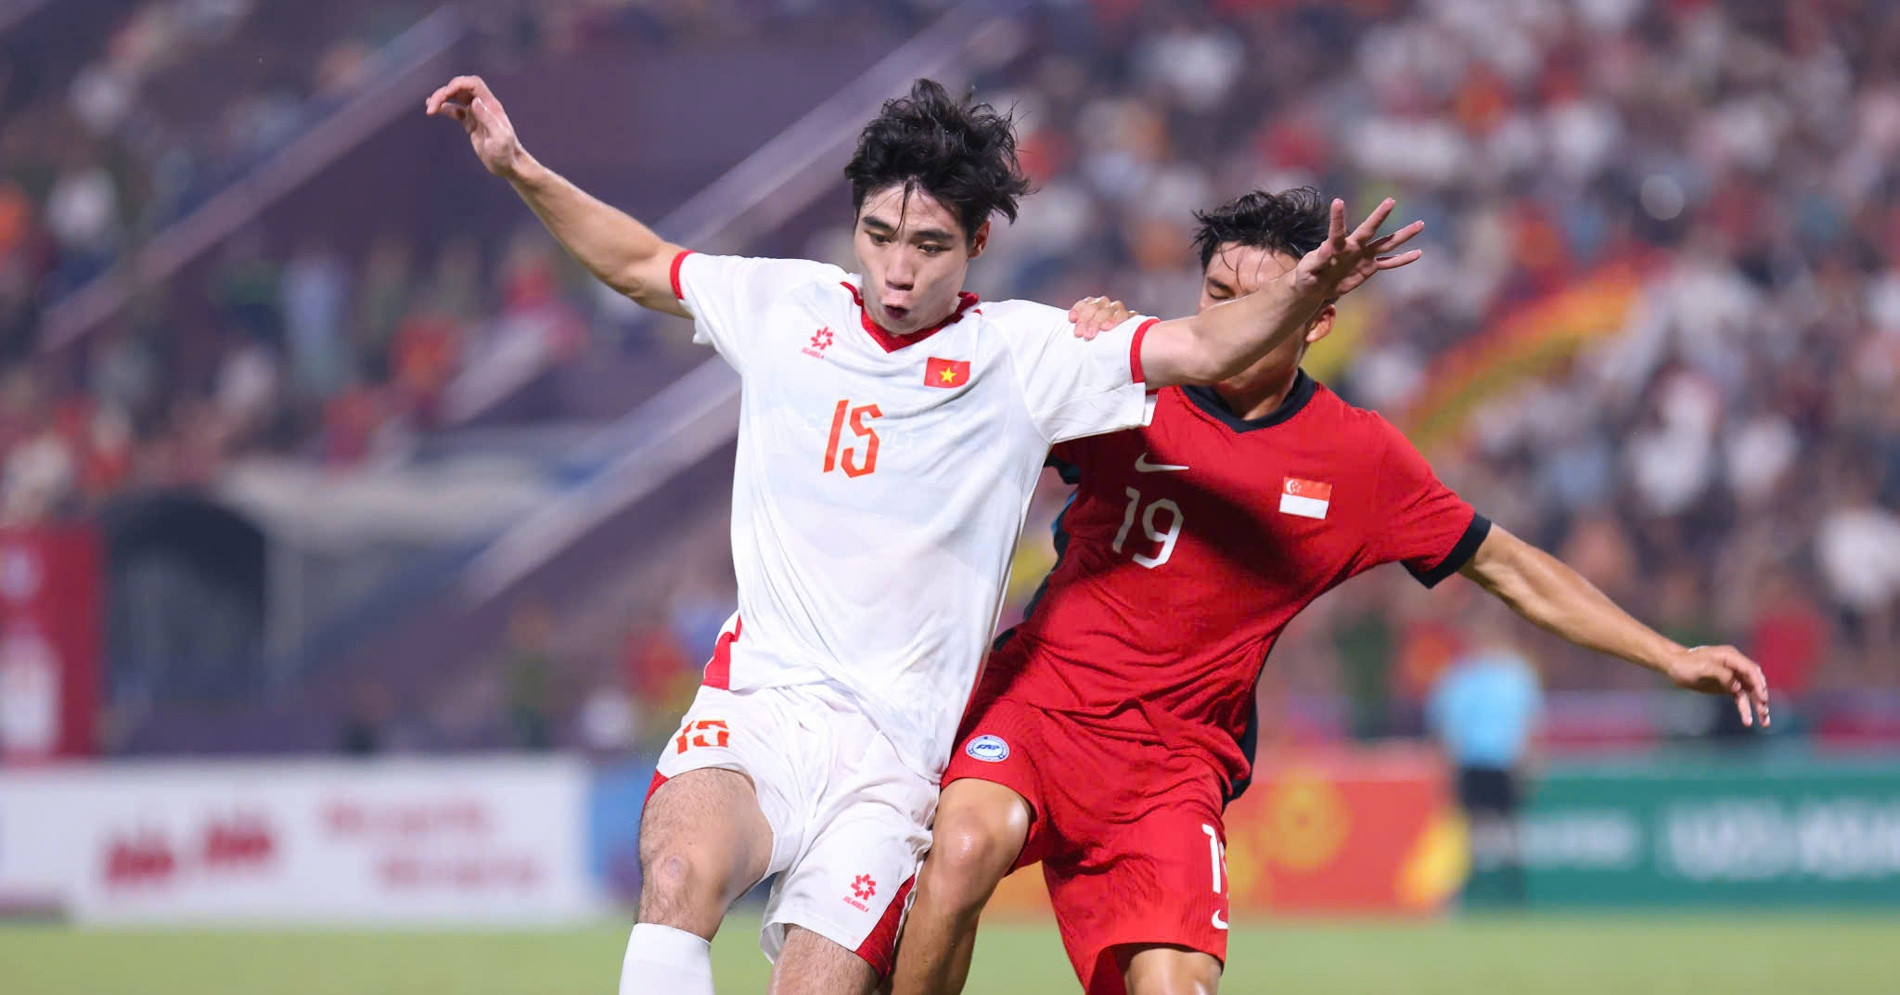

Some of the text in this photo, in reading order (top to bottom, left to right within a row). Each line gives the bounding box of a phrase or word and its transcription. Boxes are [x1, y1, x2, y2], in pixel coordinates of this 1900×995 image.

[823, 399, 884, 479] 15
[1112, 486, 1184, 570] 19
[676, 720, 730, 755] 15
[1202, 823, 1229, 899] 1
